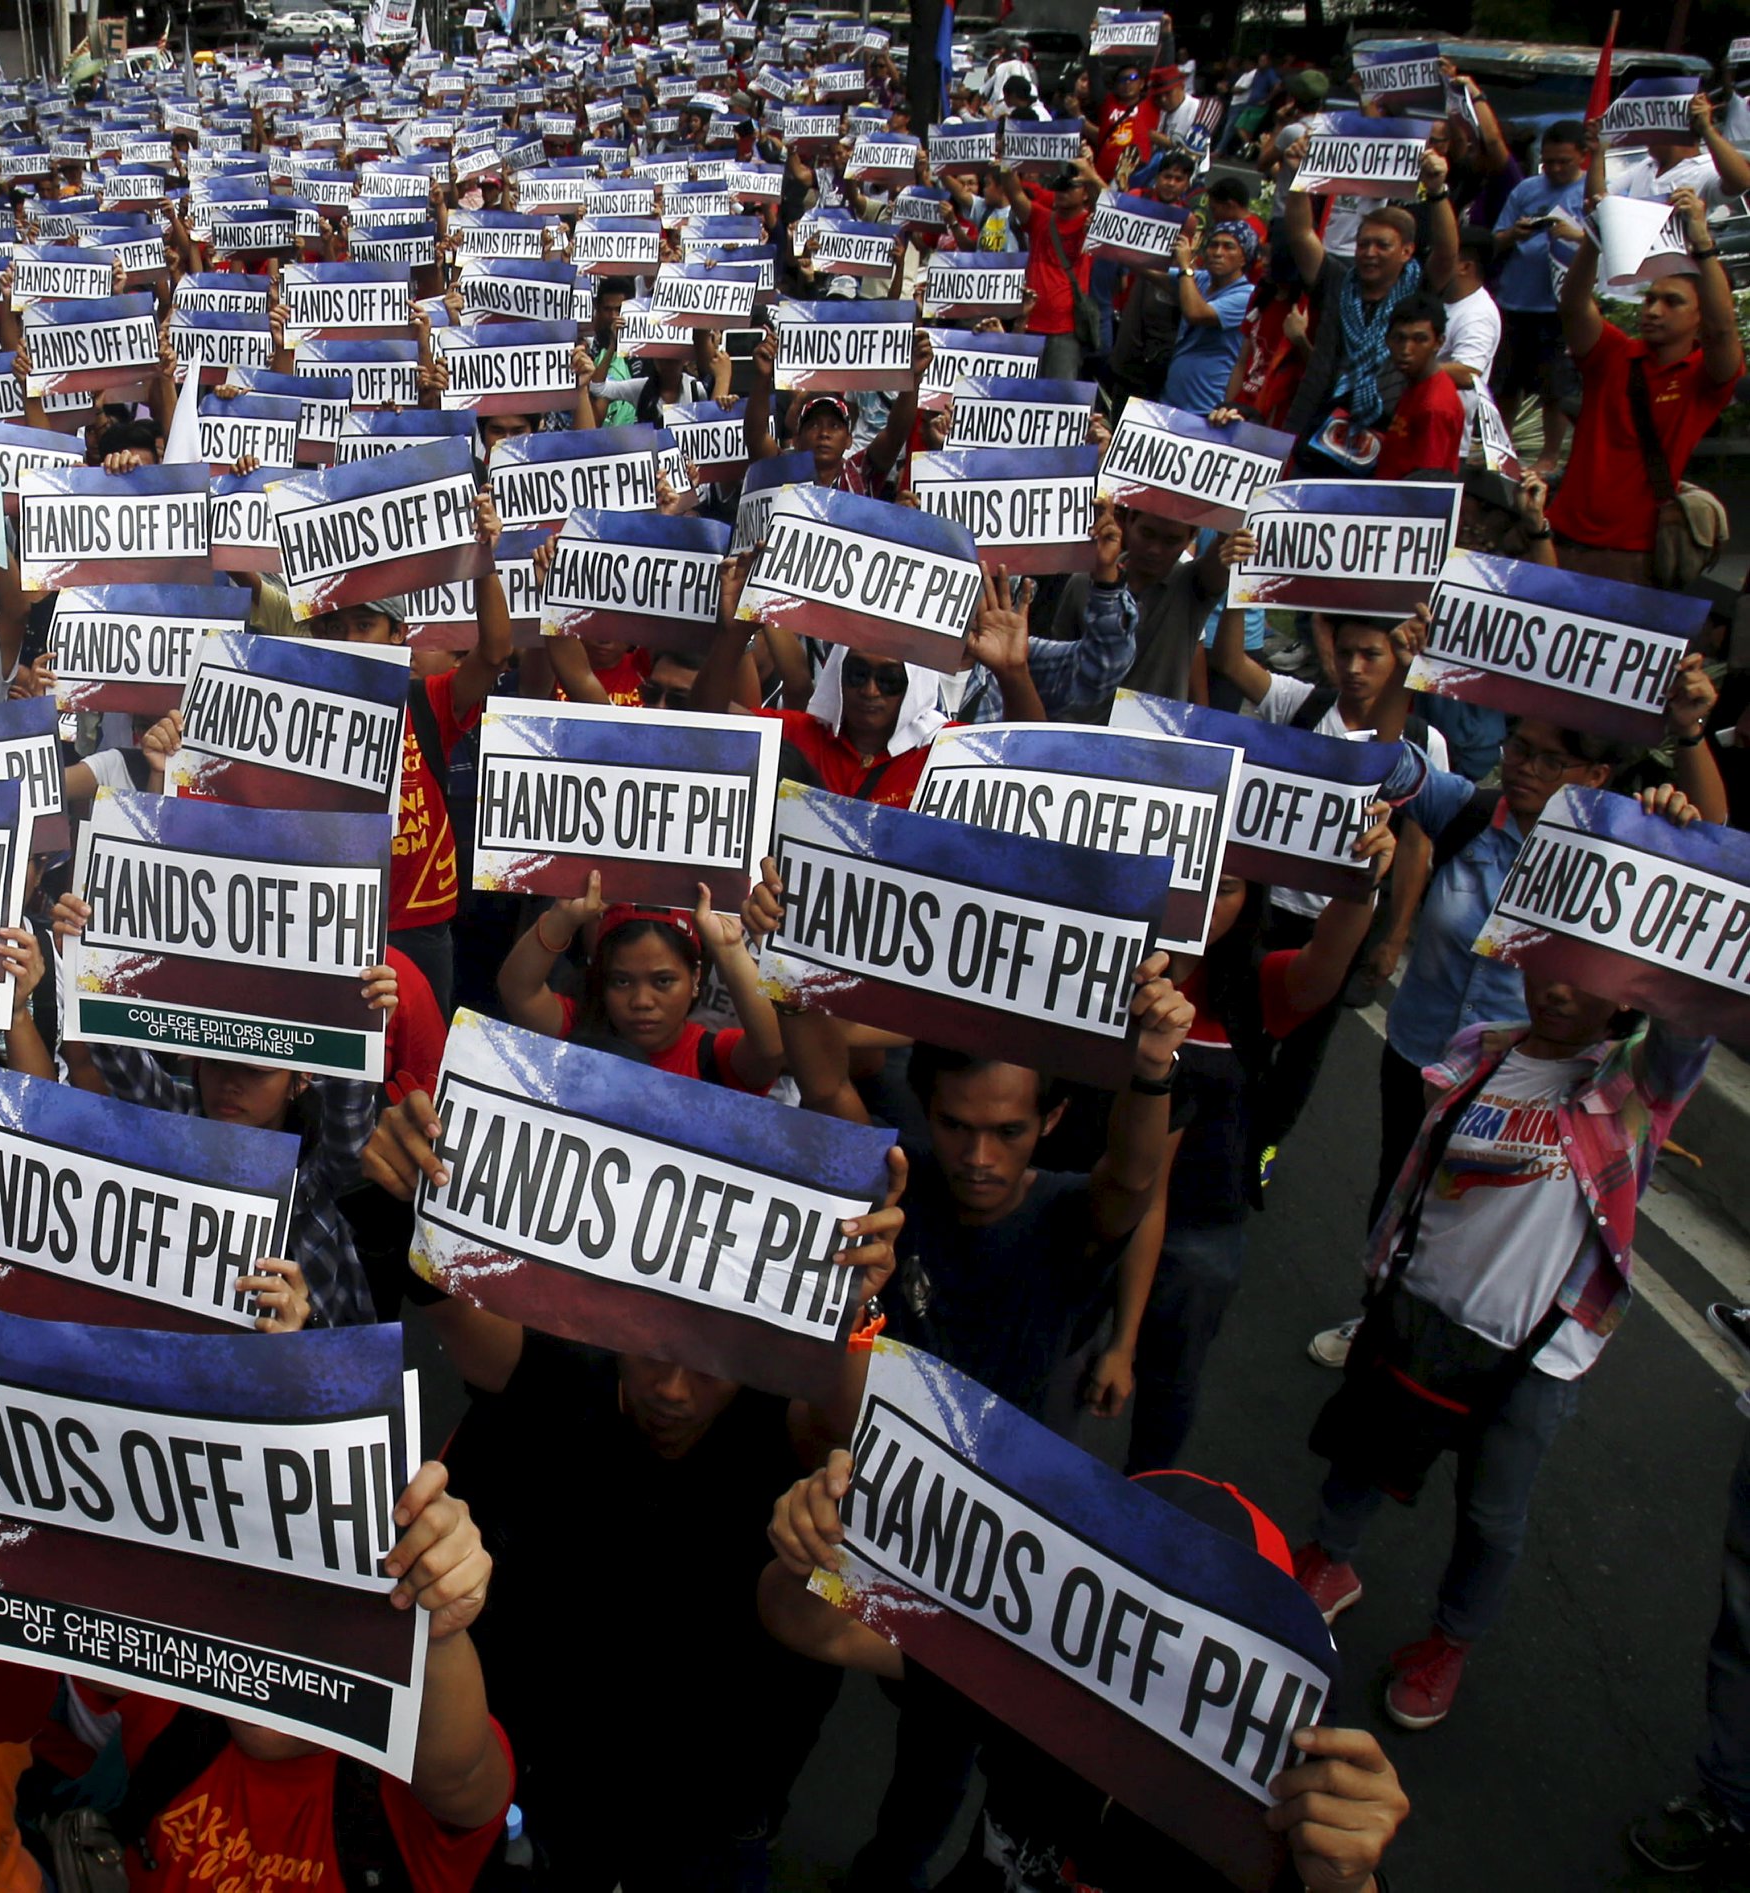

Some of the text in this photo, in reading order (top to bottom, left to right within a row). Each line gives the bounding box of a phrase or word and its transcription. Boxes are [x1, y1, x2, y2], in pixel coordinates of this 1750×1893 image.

[1644, 101, 1667, 127] OFF
[1305, 140, 1421, 178] HANDS OFF PH!
[1090, 206, 1126, 240] HANDS
[1128, 217, 1154, 248] OFF
[15, 264, 110, 296] HANDS OFF PH!
[655, 281, 754, 313] HANDS OFF PH!
[27, 320, 160, 368] HANDS OFF PH!
[779, 323, 911, 365] HANDS OFF PH!
[25, 502, 207, 554] HANDS OFF PH!
[282, 483, 477, 575] HANDS OFF PH!
[550, 548, 720, 617] HANDS OFF PH!
[753, 524, 981, 630] HANDS OFF PH!
[1428, 594, 1682, 708] HANDS OFF PH!
[184, 676, 283, 756] HANDS
[286, 697, 343, 766] OFF
[347, 709, 396, 785] PH!
[485, 769, 608, 846] HANDS
[614, 778, 679, 852] OFF
[686, 784, 747, 859] PH!
[1235, 777, 1313, 846] OFF
[87, 855, 378, 968] HANDS OFF PH!
[1503, 830, 1724, 963] HANDS OFF
[779, 855, 1145, 1028] HANDS OFF PH!
[128, 1007, 315, 1046] COLLEGE EDITORS GUILD
[148, 1023, 294, 1056] OF THE PHILIPPINES
[1456, 1102, 1507, 1141] YAN
[90, 1179, 178, 1289] OFF
[437, 1098, 848, 1327] HANDS OFF PH!
[121, 1430, 244, 1549] OFF
[263, 1443, 392, 1578] PH!
[842, 1424, 1046, 1636] HANDS
[1049, 1565, 1185, 1707] OFF
[22, 1622, 270, 1701] OF THE PHILIPPINES
[64, 1612, 198, 1663] CHRISTIAN
[206, 1645, 356, 1704] MOVEMENT
